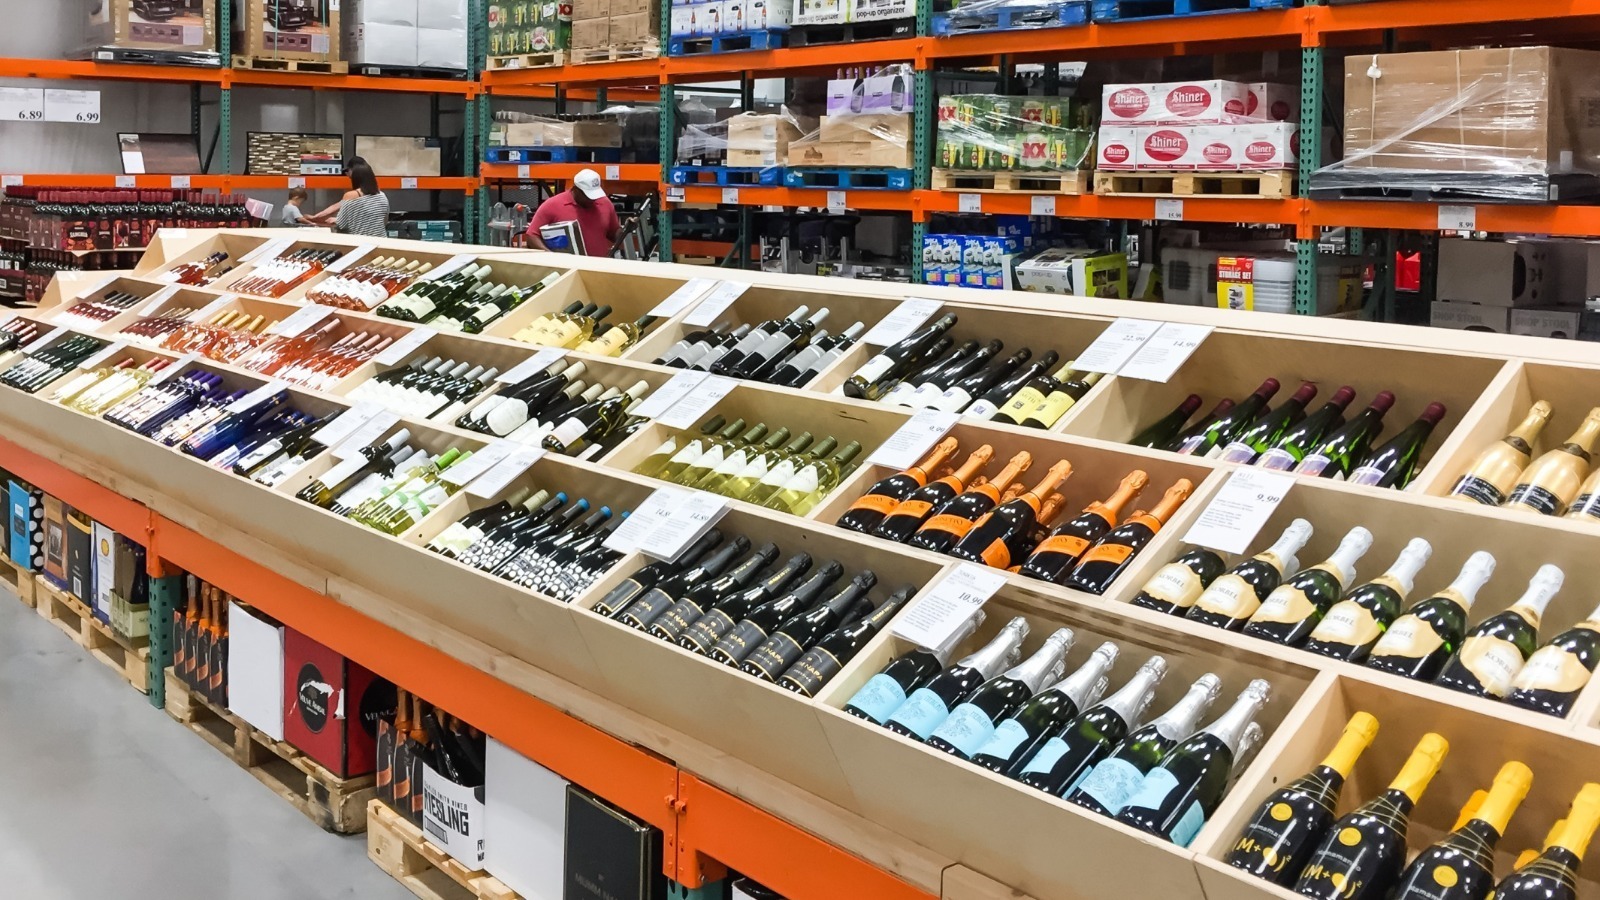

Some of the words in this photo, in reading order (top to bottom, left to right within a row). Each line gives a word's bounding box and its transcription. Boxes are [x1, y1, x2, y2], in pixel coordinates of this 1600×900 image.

[856, 9, 876, 18] pop-up
[877, 7, 905, 16] organizer
[1114, 91, 1144, 105] Shiner
[1171, 91, 1205, 102] Shiner
[18, 110, 42, 120] 6.89
[76, 112, 99, 122] 6.99
[1150, 135, 1182, 148] Shiner
[1022, 143, 1047, 158] XX
[1106, 147, 1127, 155] Shiner
[1207, 145, 1229, 155] Shiner
[1249, 145, 1273, 154] Shiner
[1218, 270, 1241, 279] STORAGE
[1242, 271, 1252, 280] SET
[1257, 493, 1280, 503] 9.99
[958, 592, 984, 606] 10.99
[730, 633, 747, 648] NAPA
[766, 649, 784, 665] NAPA
[804, 664, 823, 682] NAPA
[424, 787, 470, 837] RIESLING
